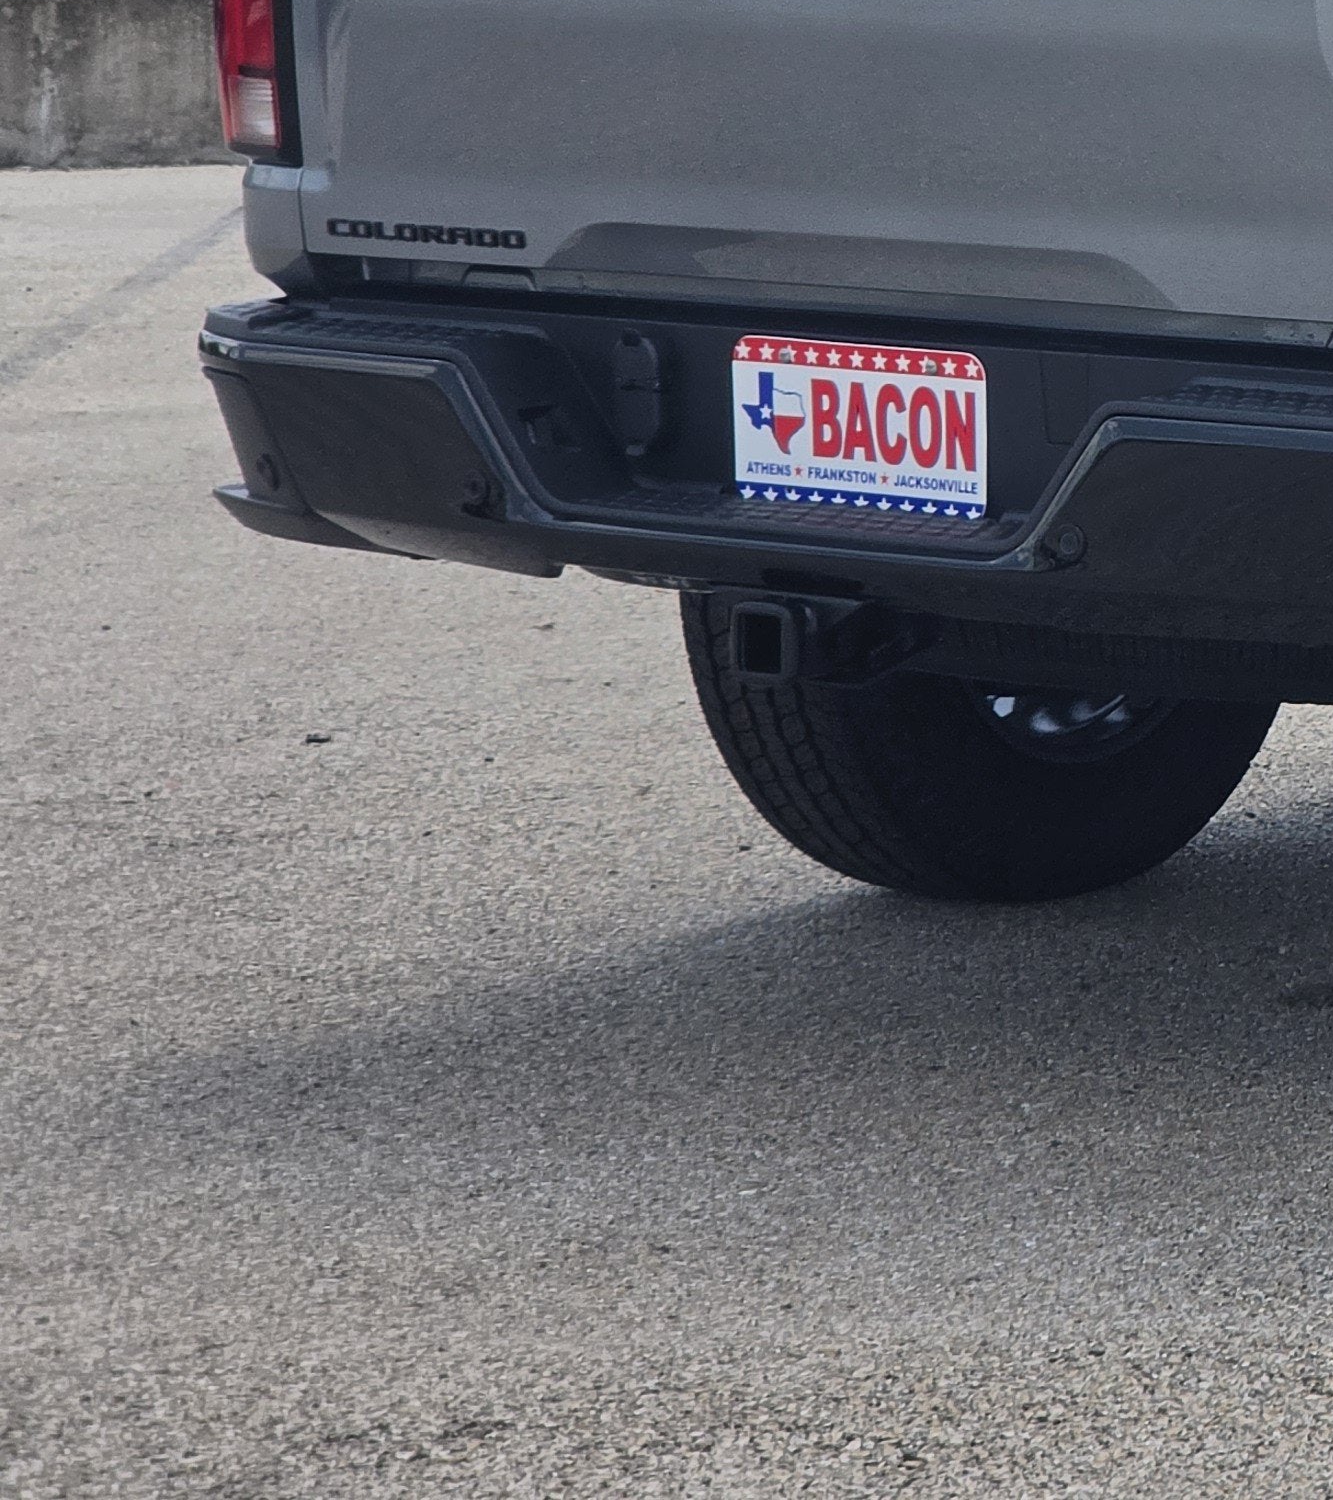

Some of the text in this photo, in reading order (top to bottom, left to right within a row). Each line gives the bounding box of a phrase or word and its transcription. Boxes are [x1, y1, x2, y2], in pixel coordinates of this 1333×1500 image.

[327, 217, 526, 250] COLORADO
[810, 378, 977, 473] BACON
[746, 461, 978, 495] ATHENS FRANKSTON JACKSONVILLE
